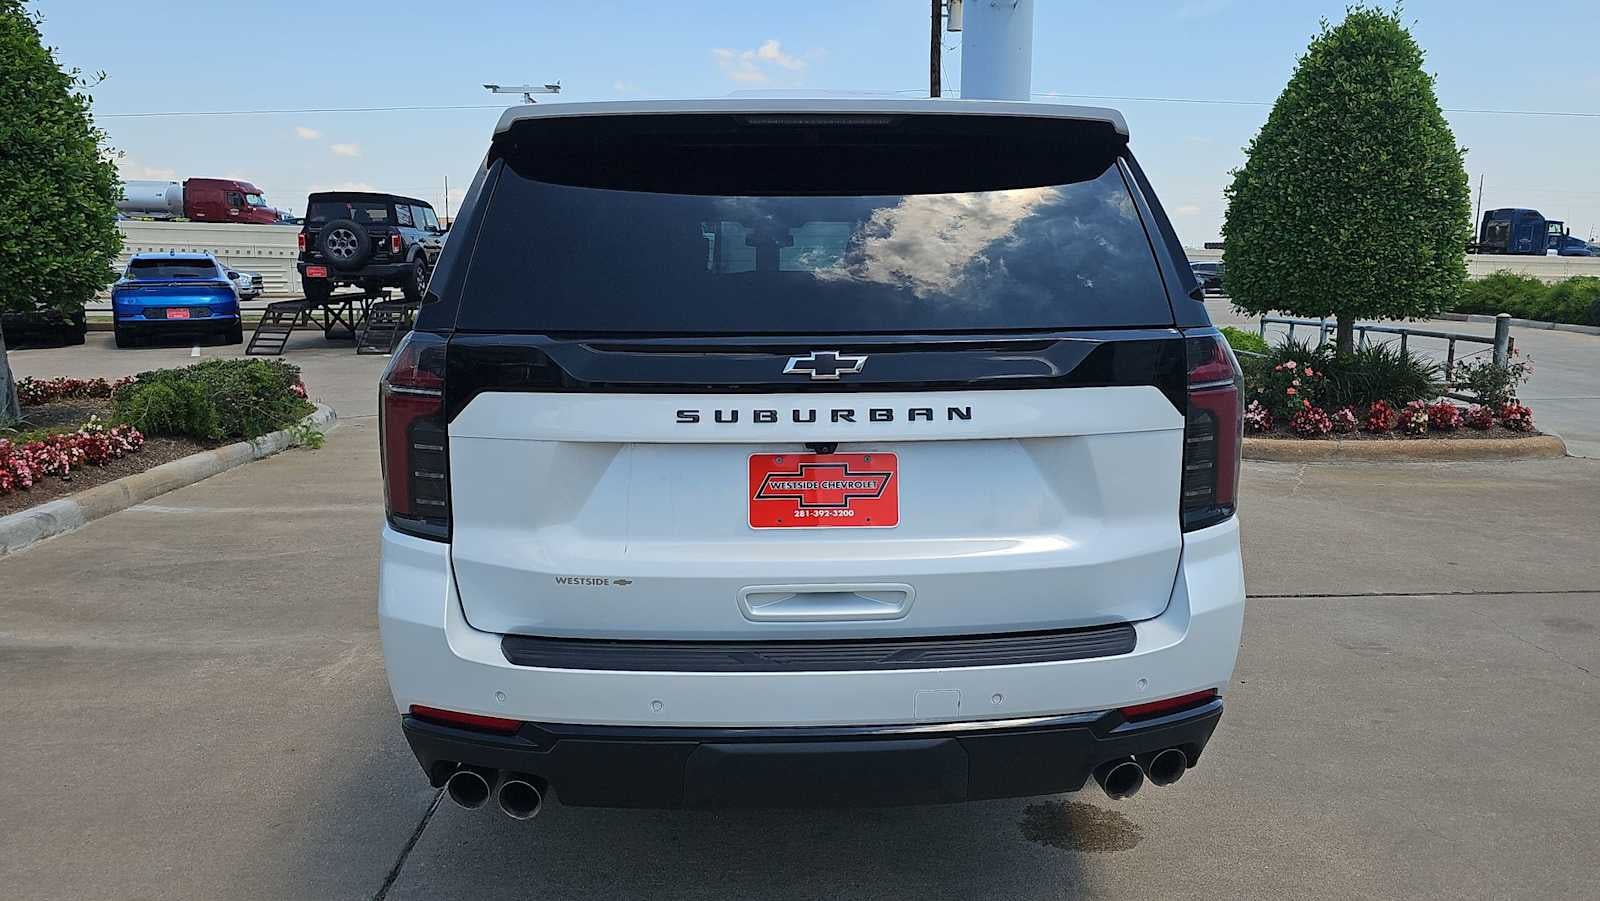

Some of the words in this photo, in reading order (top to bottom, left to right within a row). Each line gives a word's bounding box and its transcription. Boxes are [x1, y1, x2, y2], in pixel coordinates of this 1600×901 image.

[676, 406, 973, 424] SUBURBAN
[769, 480, 818, 490] WESTSIDE
[821, 480, 878, 490] CHEVROLET
[793, 509, 855, 518] 281-392-3200
[555, 576, 609, 586] WESTSIDE
